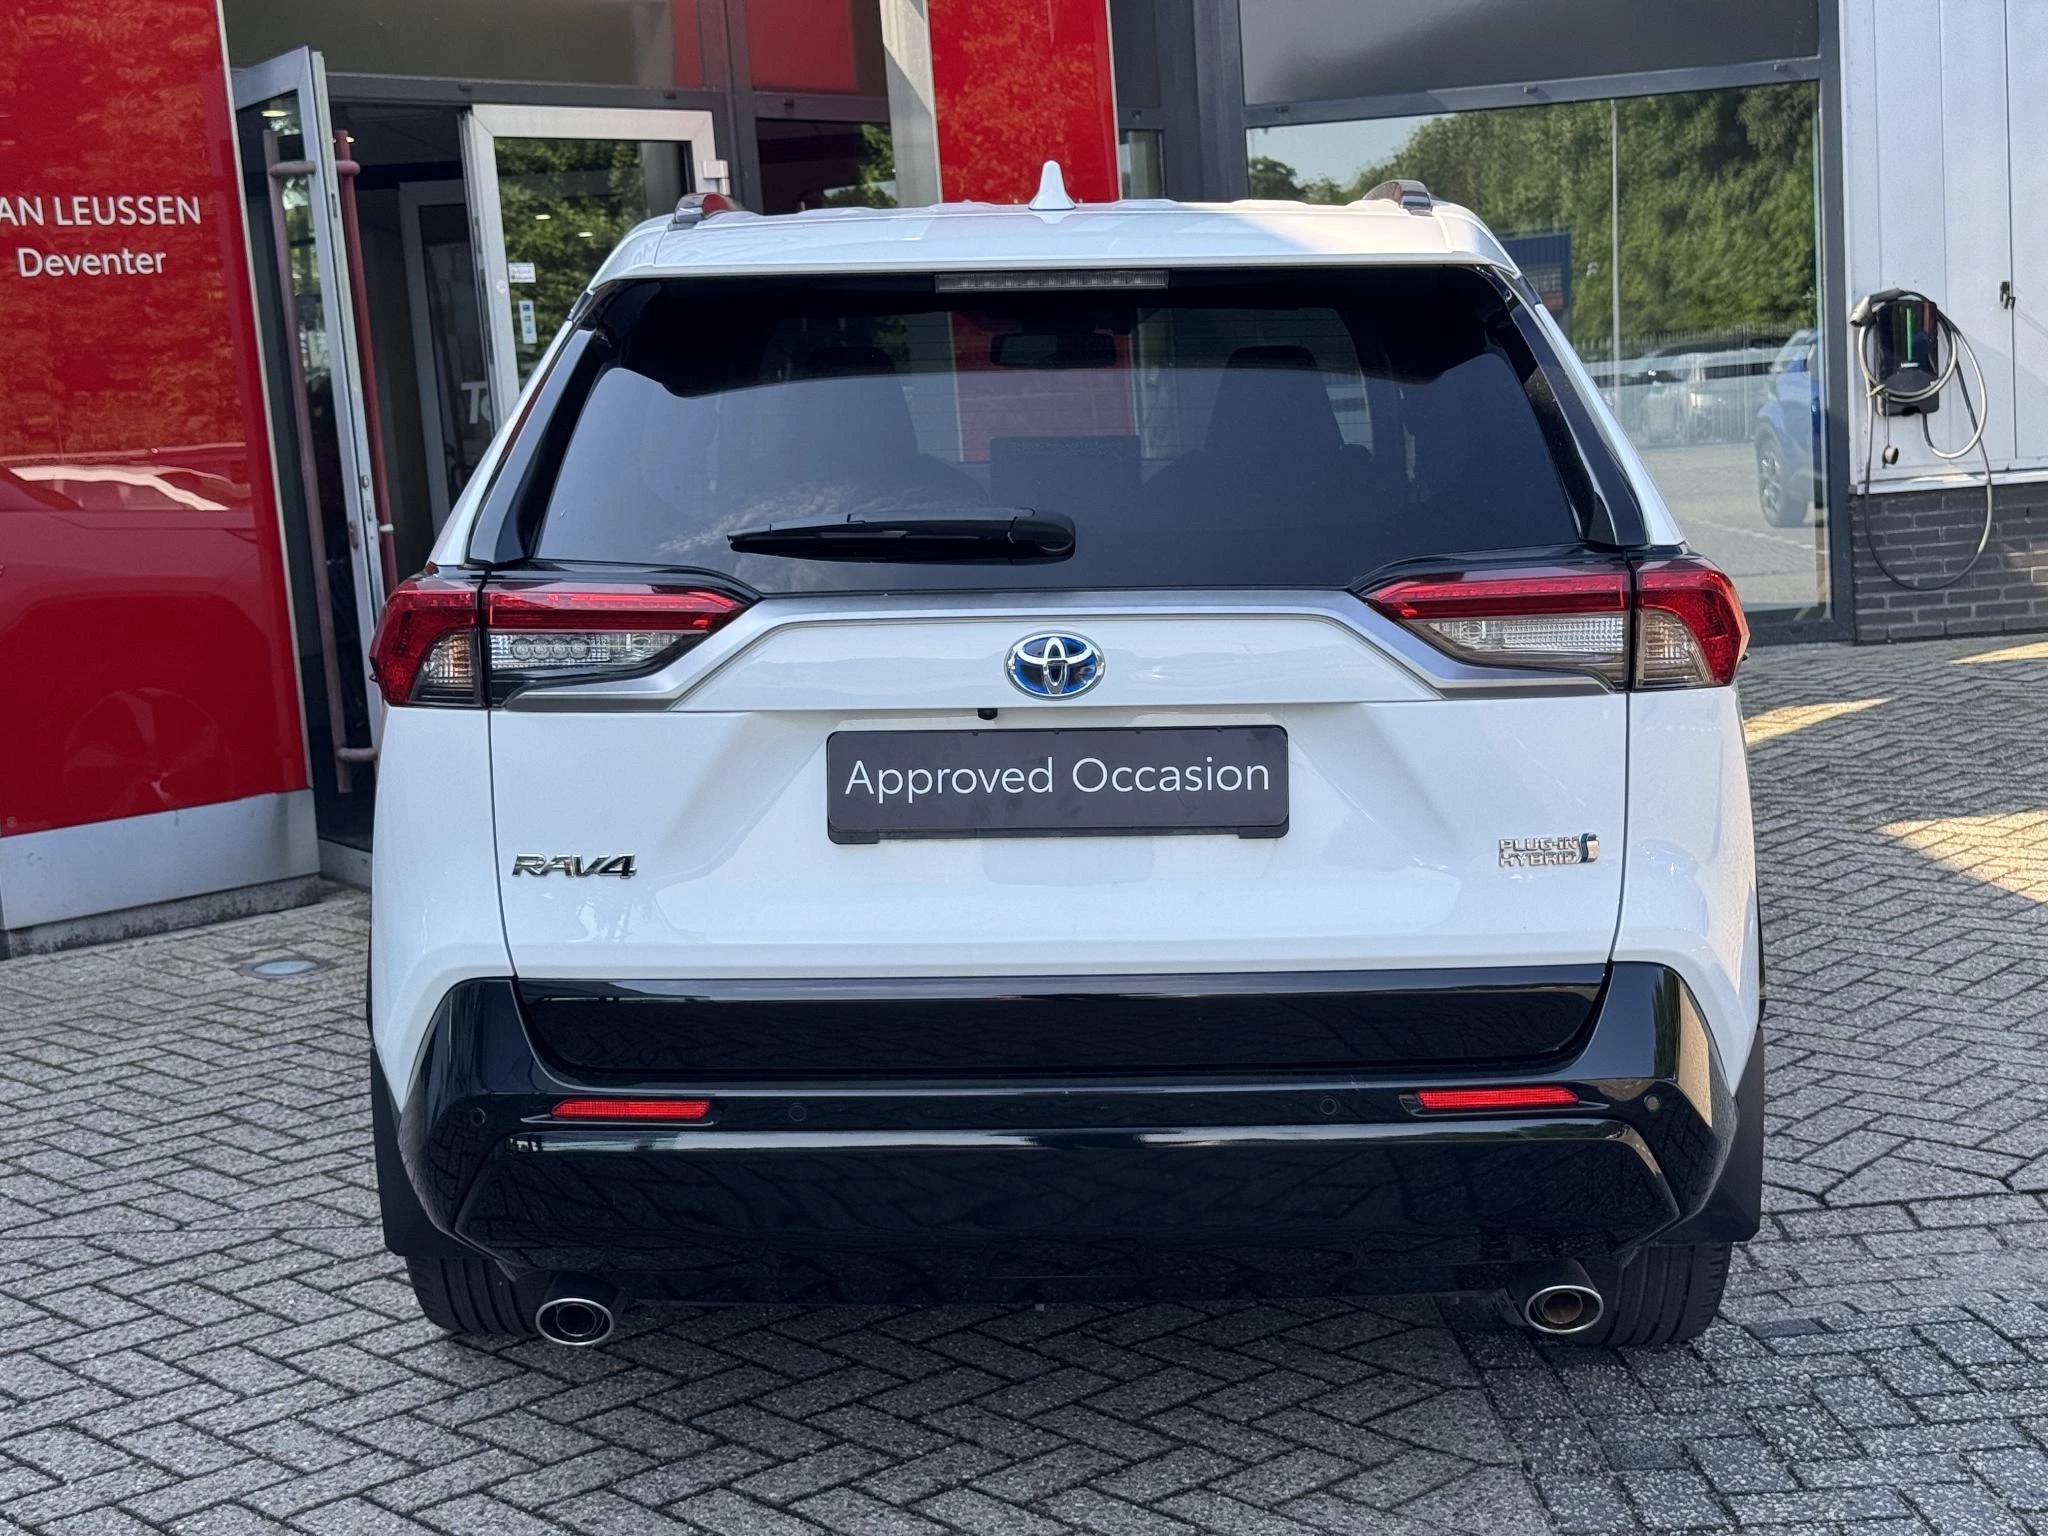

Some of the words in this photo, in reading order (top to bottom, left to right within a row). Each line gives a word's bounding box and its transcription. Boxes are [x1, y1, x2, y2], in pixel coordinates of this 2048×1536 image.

[53, 195, 202, 226] LEUSSEN
[17, 246, 167, 278] Deventer
[845, 756, 1054, 804] Approved
[1072, 756, 1270, 794] Occasion
[1499, 836, 1579, 852] PLUG-IN
[512, 853, 637, 880] RAV4
[1499, 850, 1579, 868] HYBRID
